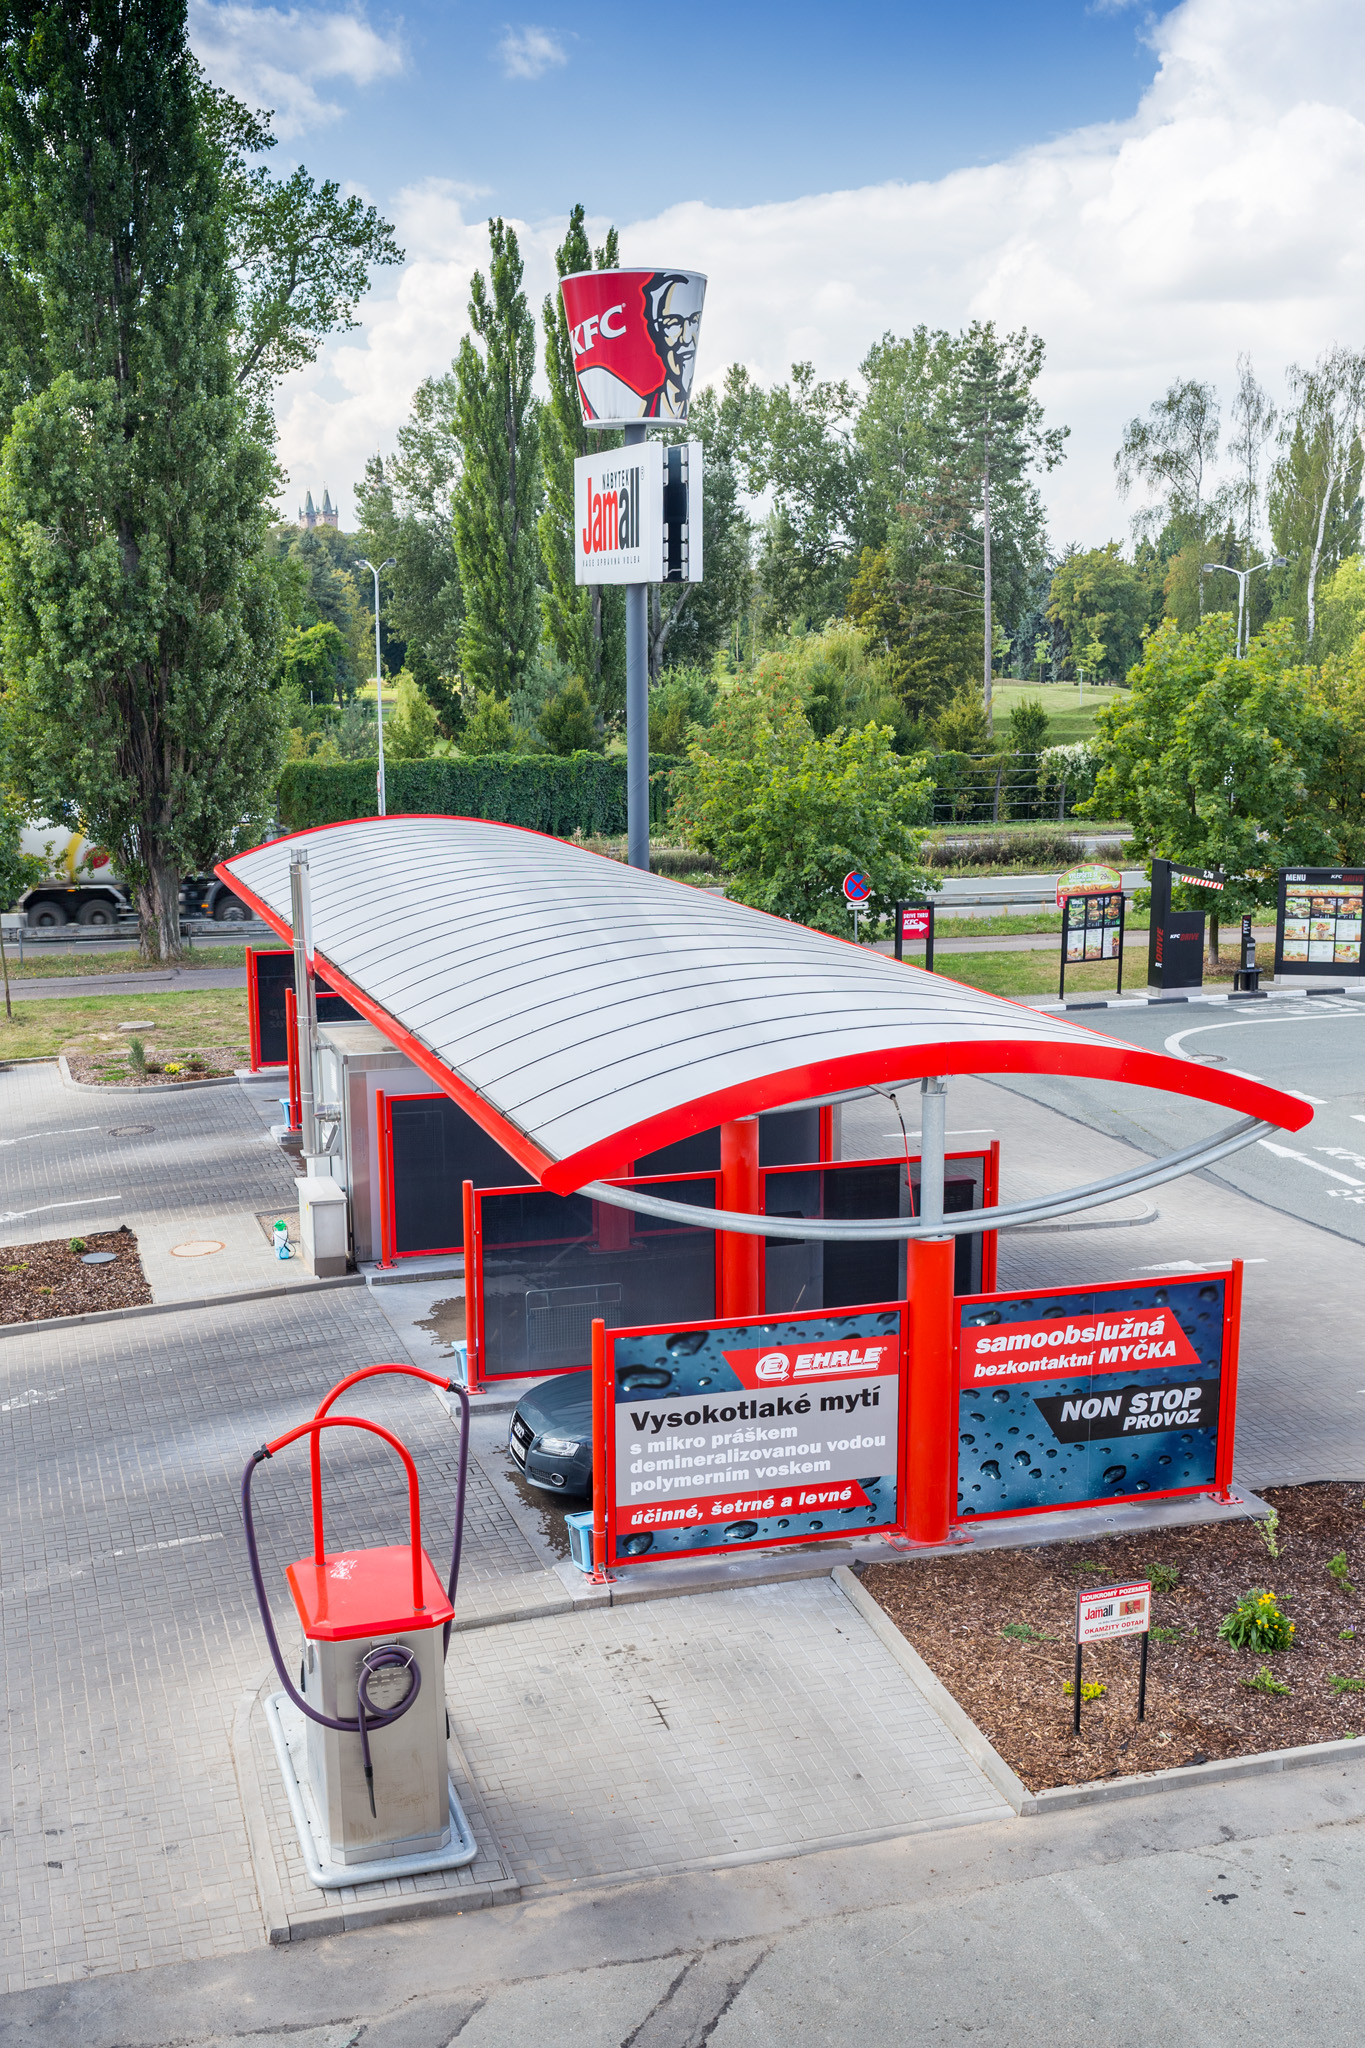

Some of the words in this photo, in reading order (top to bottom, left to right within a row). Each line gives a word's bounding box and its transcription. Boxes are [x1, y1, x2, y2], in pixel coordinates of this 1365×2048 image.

[569, 304, 627, 360] KFC
[602, 468, 630, 490] NÁBYTEK
[582, 467, 640, 555] Jamall
[1285, 873, 1307, 882] MENU
[1342, 874, 1364, 882] DRIVE
[1155, 926, 1164, 963] DRIVE
[1180, 933, 1200, 941] DRIVE
[975, 1314, 1166, 1354] samoobslužná
[794, 1347, 882, 1370] EHRLE
[973, 1350, 1096, 1378] bezkontaktní
[1098, 1339, 1176, 1365] MYČKA
[630, 1394, 812, 1434] Vysokotlaké
[820, 1385, 881, 1414] mytí
[1060, 1396, 1122, 1423] NON
[1128, 1387, 1203, 1414] STOP
[1122, 1408, 1202, 1431] PROVOZ
[630, 1443, 641, 1455] s
[647, 1435, 706, 1454] mikro
[711, 1426, 798, 1449] práškem
[630, 1439, 821, 1474] demineralizovanou
[826, 1433, 886, 1452] vodou
[630, 1468, 749, 1495] polymerním
[755, 1458, 831, 1478] voskem
[630, 1504, 704, 1526] účinné,
[711, 1495, 775, 1516] šetrné
[780, 1495, 793, 1507] a
[799, 1486, 853, 1506] levné
[1082, 1589, 1117, 1601] SOUKROMÝ
[1119, 1585, 1150, 1595] POZEMEK
[1085, 1604, 1113, 1621] Jamall
[1121, 1619, 1144, 1628] ODTAH
